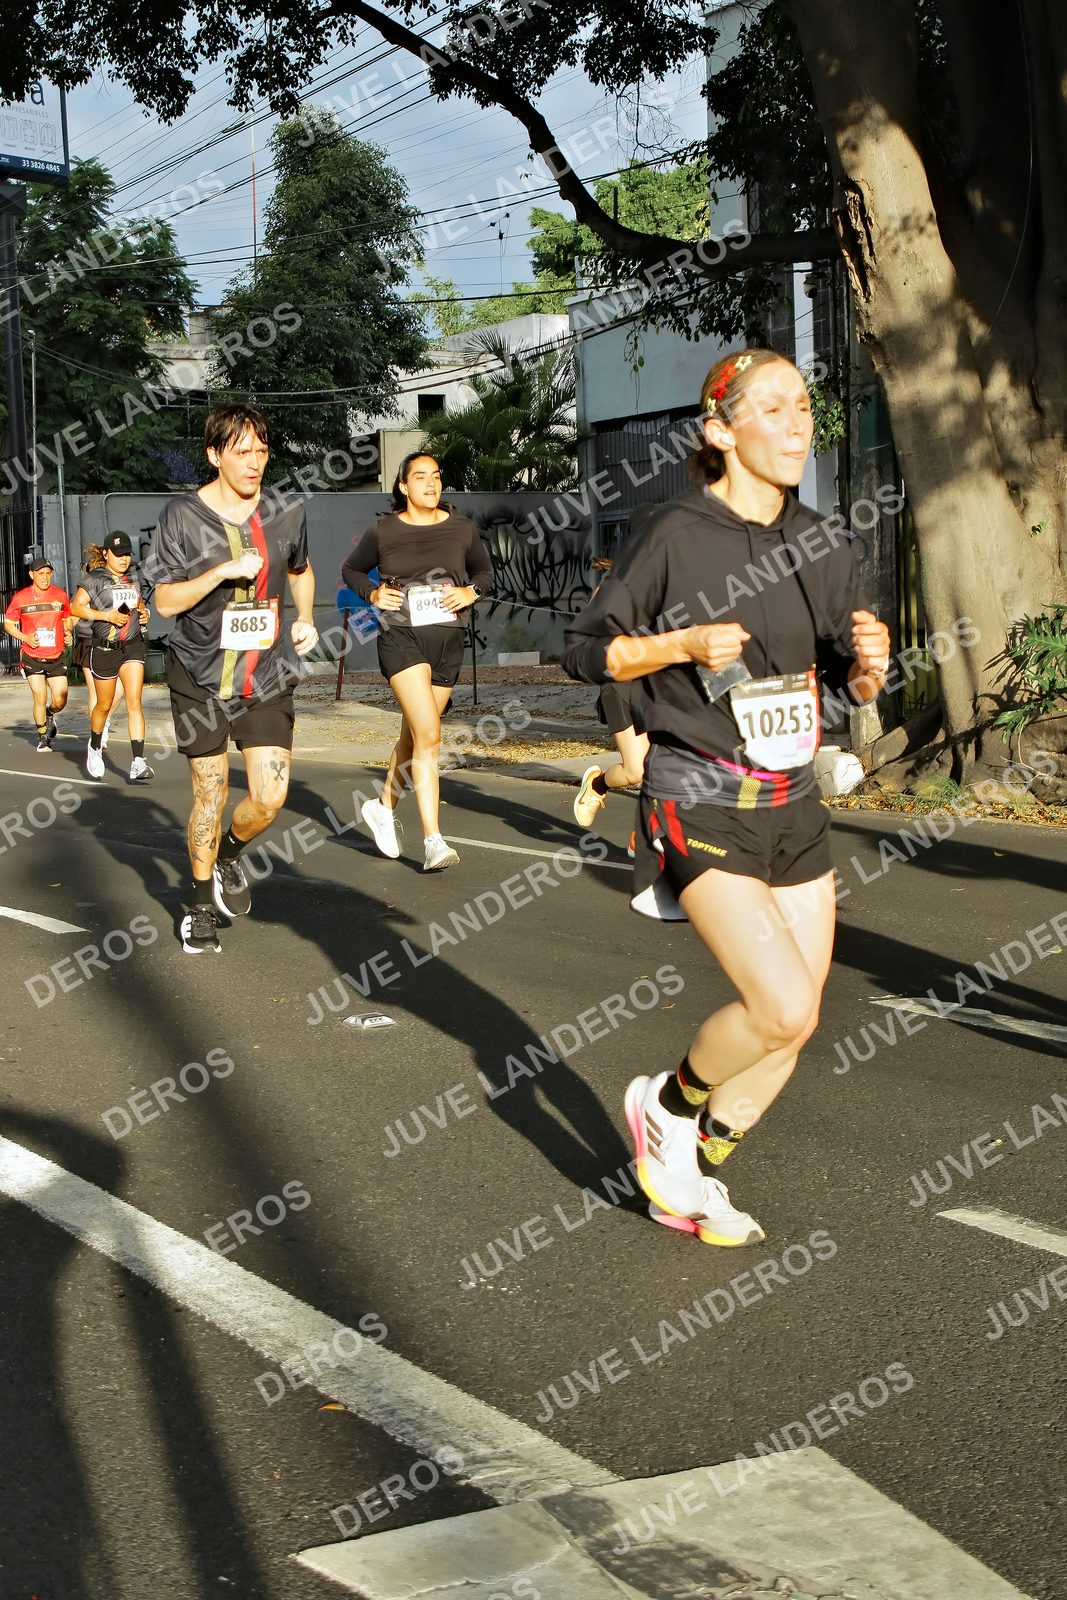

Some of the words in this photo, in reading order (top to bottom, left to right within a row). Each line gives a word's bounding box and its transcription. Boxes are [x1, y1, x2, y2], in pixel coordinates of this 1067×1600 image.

[31, 161, 45, 170] 3826
[46, 163, 60, 172] 4845
[115, 591, 137, 601] 13276
[230, 616, 268, 633] 8685
[743, 703, 813, 739] 10253
[687, 838, 728, 857] TOPTIME
